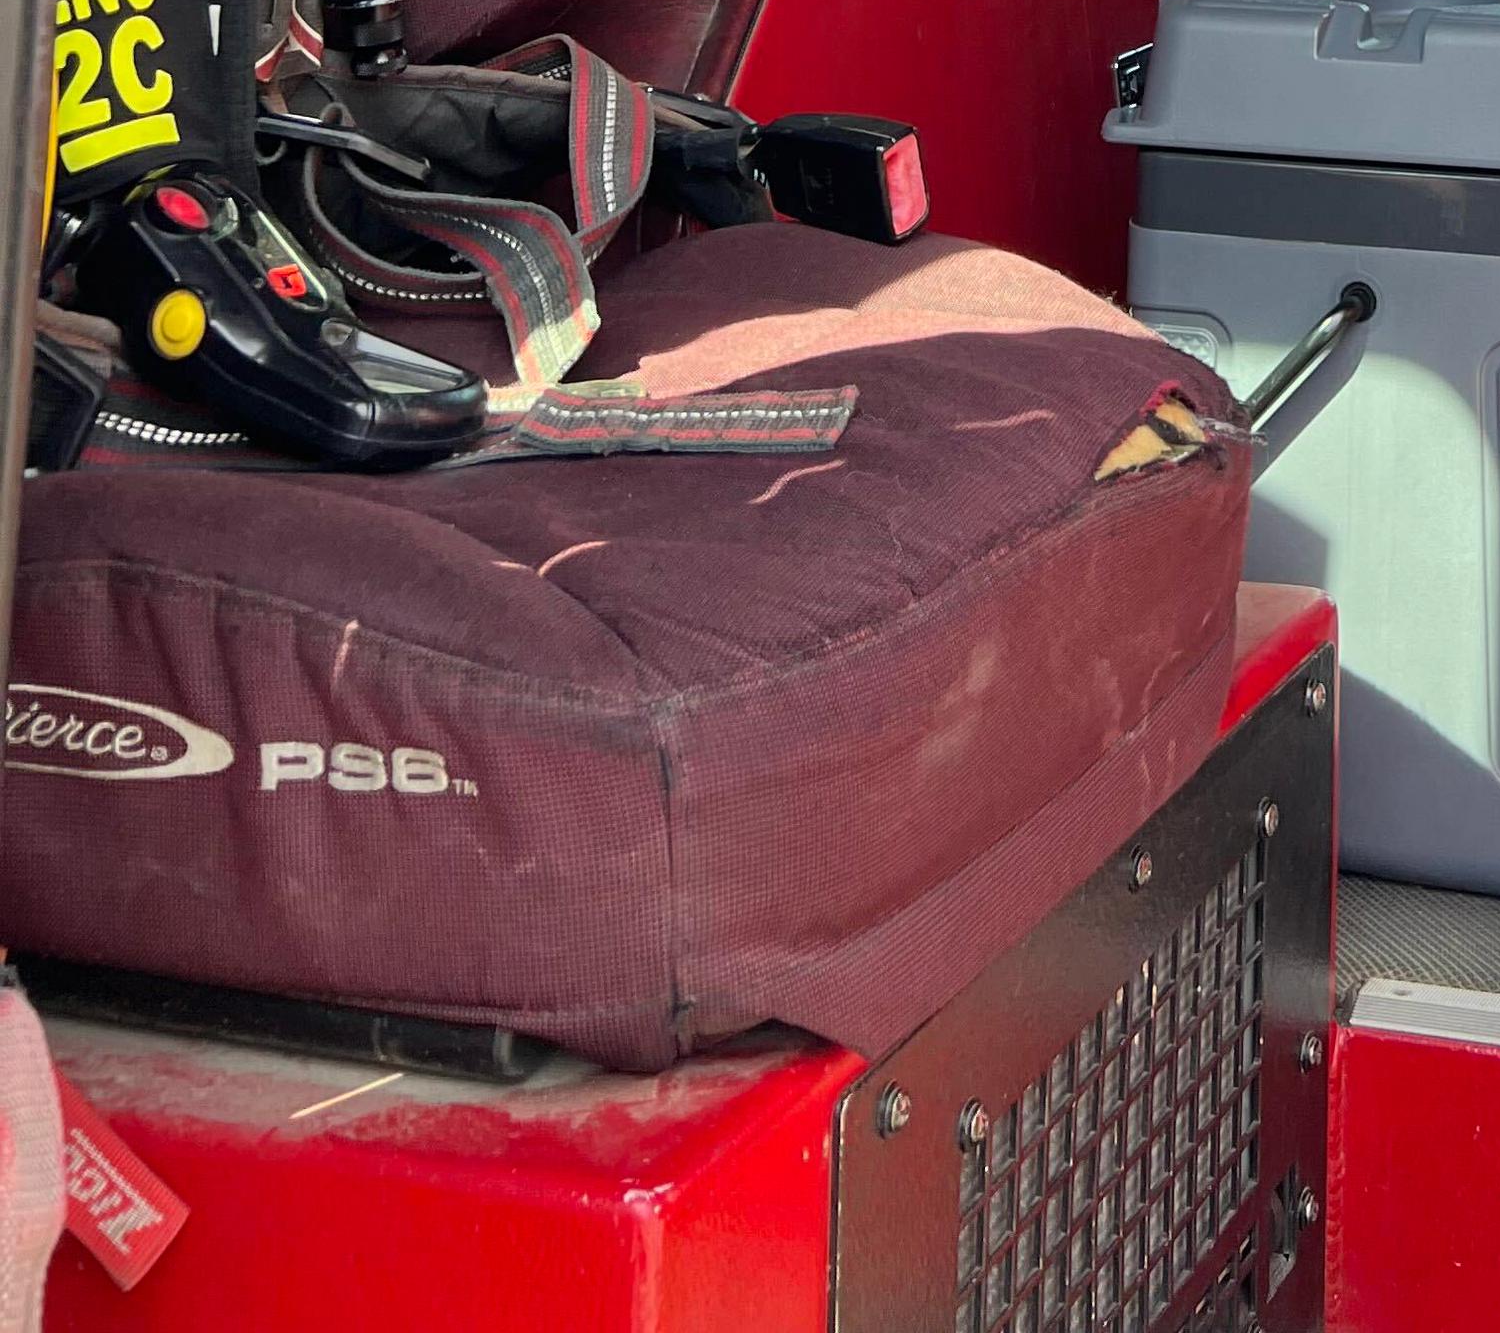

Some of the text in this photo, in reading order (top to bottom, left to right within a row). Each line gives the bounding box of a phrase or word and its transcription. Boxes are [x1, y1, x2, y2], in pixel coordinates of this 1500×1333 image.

[54, 15, 174, 137] 2C
[4, 698, 147, 760] ierce
[259, 741, 450, 794] PS6
